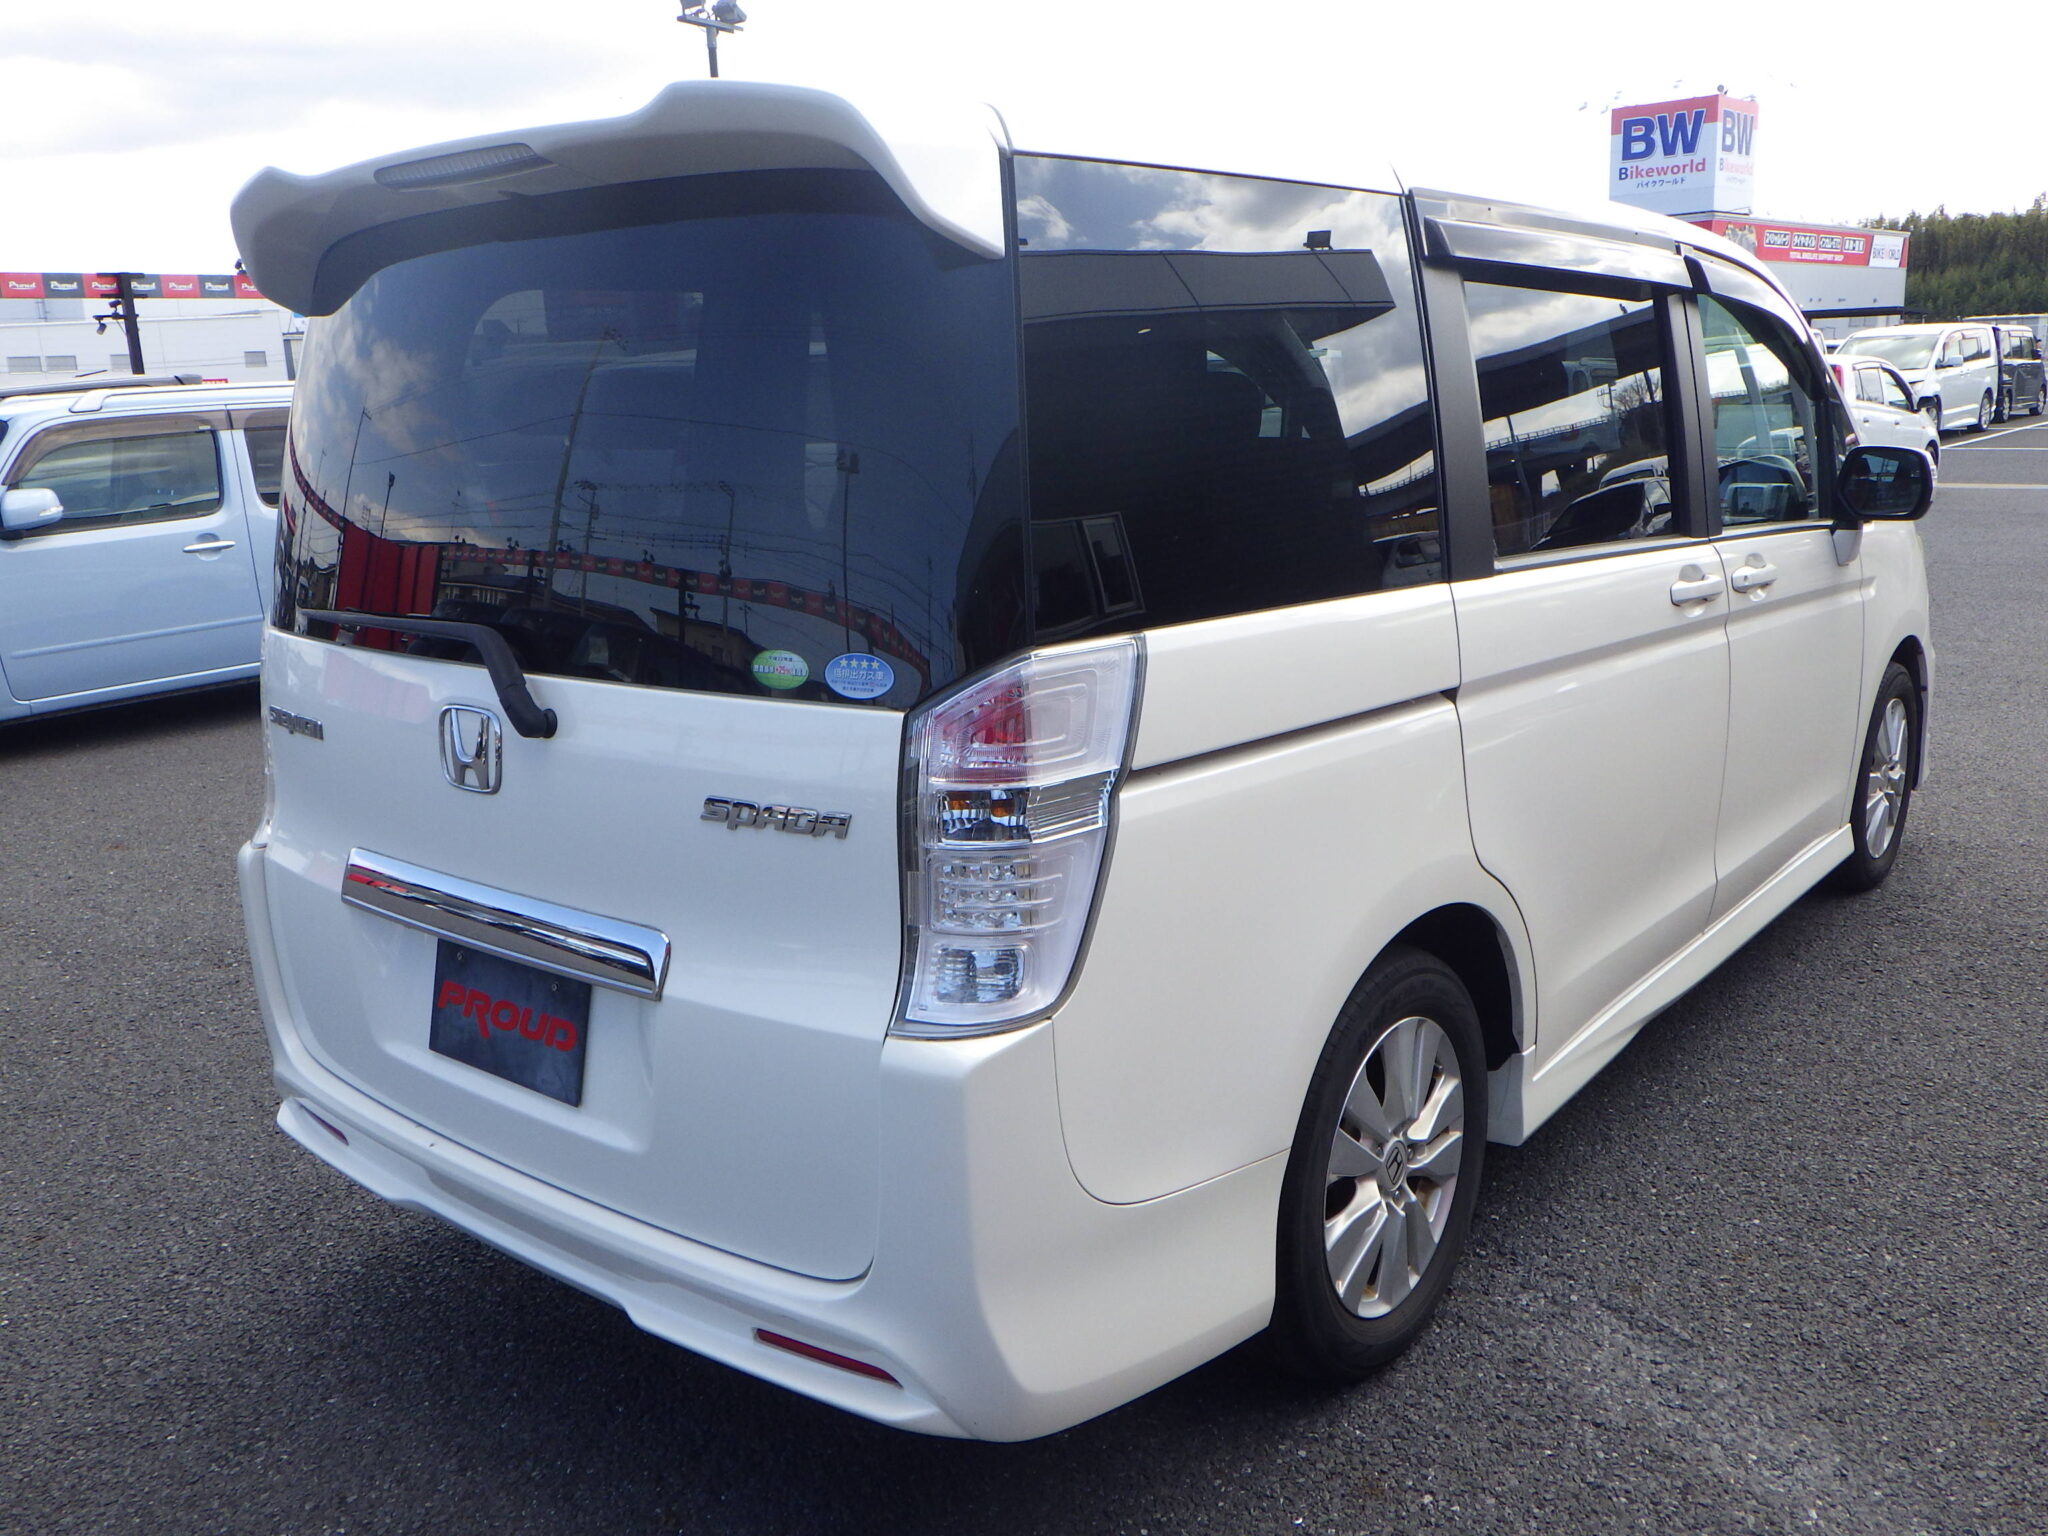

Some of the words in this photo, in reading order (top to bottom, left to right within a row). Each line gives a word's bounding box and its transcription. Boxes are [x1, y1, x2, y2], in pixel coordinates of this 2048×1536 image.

[1621, 109, 1706, 161] BW
[1721, 109, 1754, 156] BW
[1618, 158, 1706, 181] Bikeworld
[700, 795, 852, 840] SPADA
[437, 980, 578, 1052] PROUD
